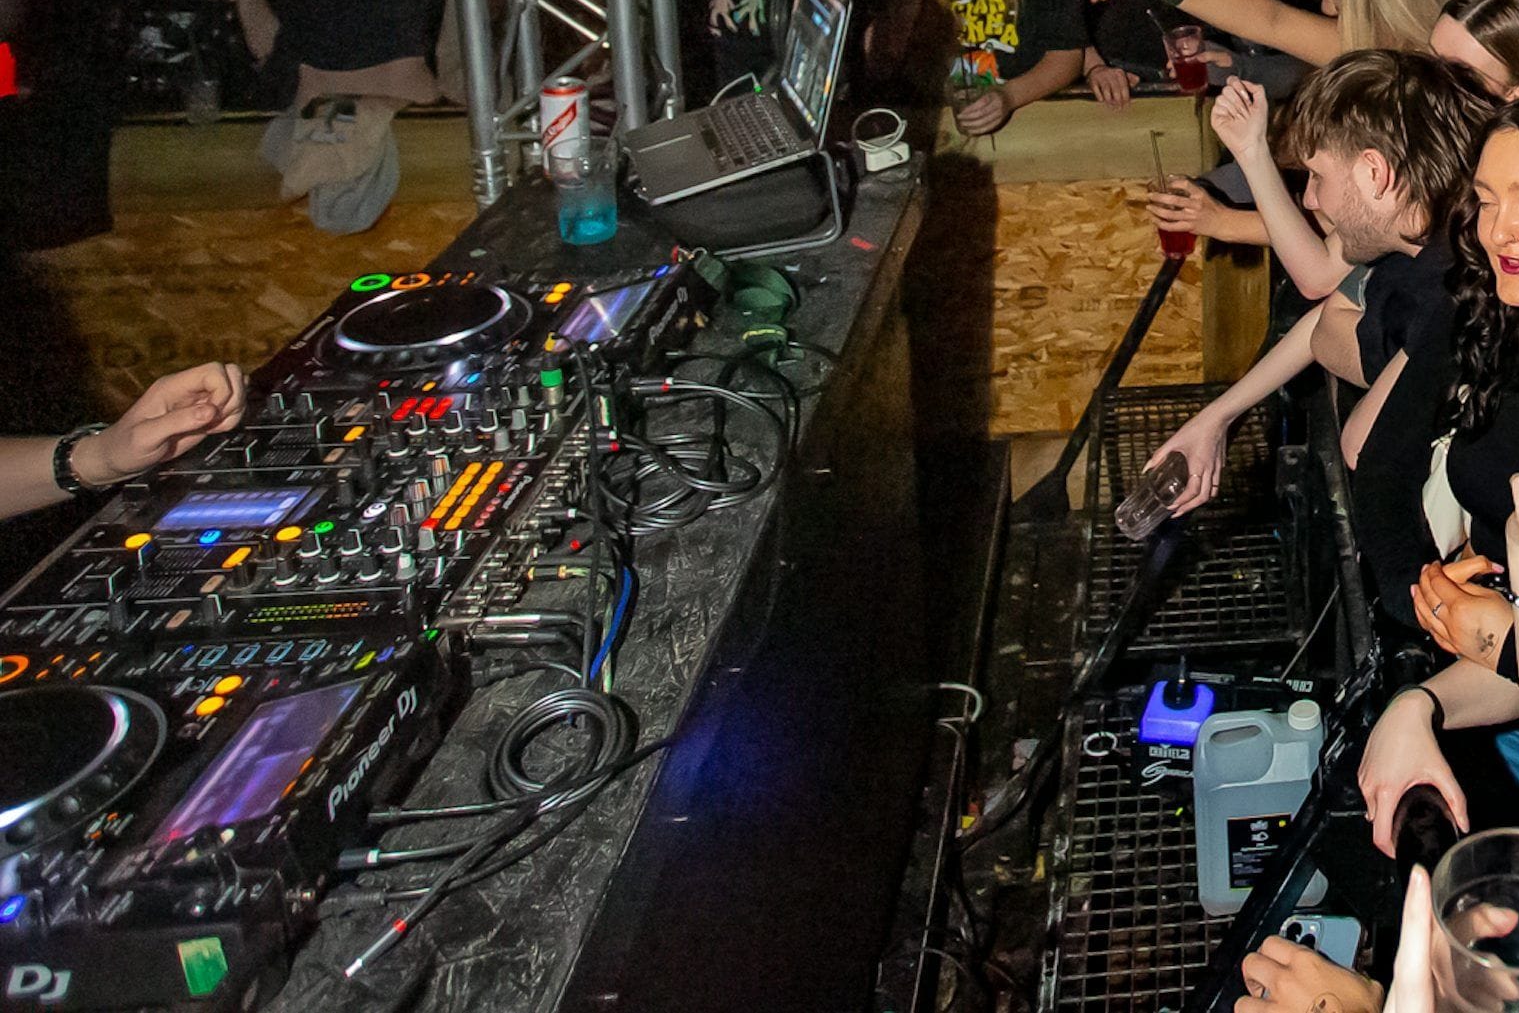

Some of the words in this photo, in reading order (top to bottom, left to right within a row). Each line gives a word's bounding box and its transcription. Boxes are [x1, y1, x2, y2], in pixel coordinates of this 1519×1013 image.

[328, 713, 397, 824] Pioneer
[396, 685, 418, 720] DJ
[6, 963, 72, 1001] DJ
